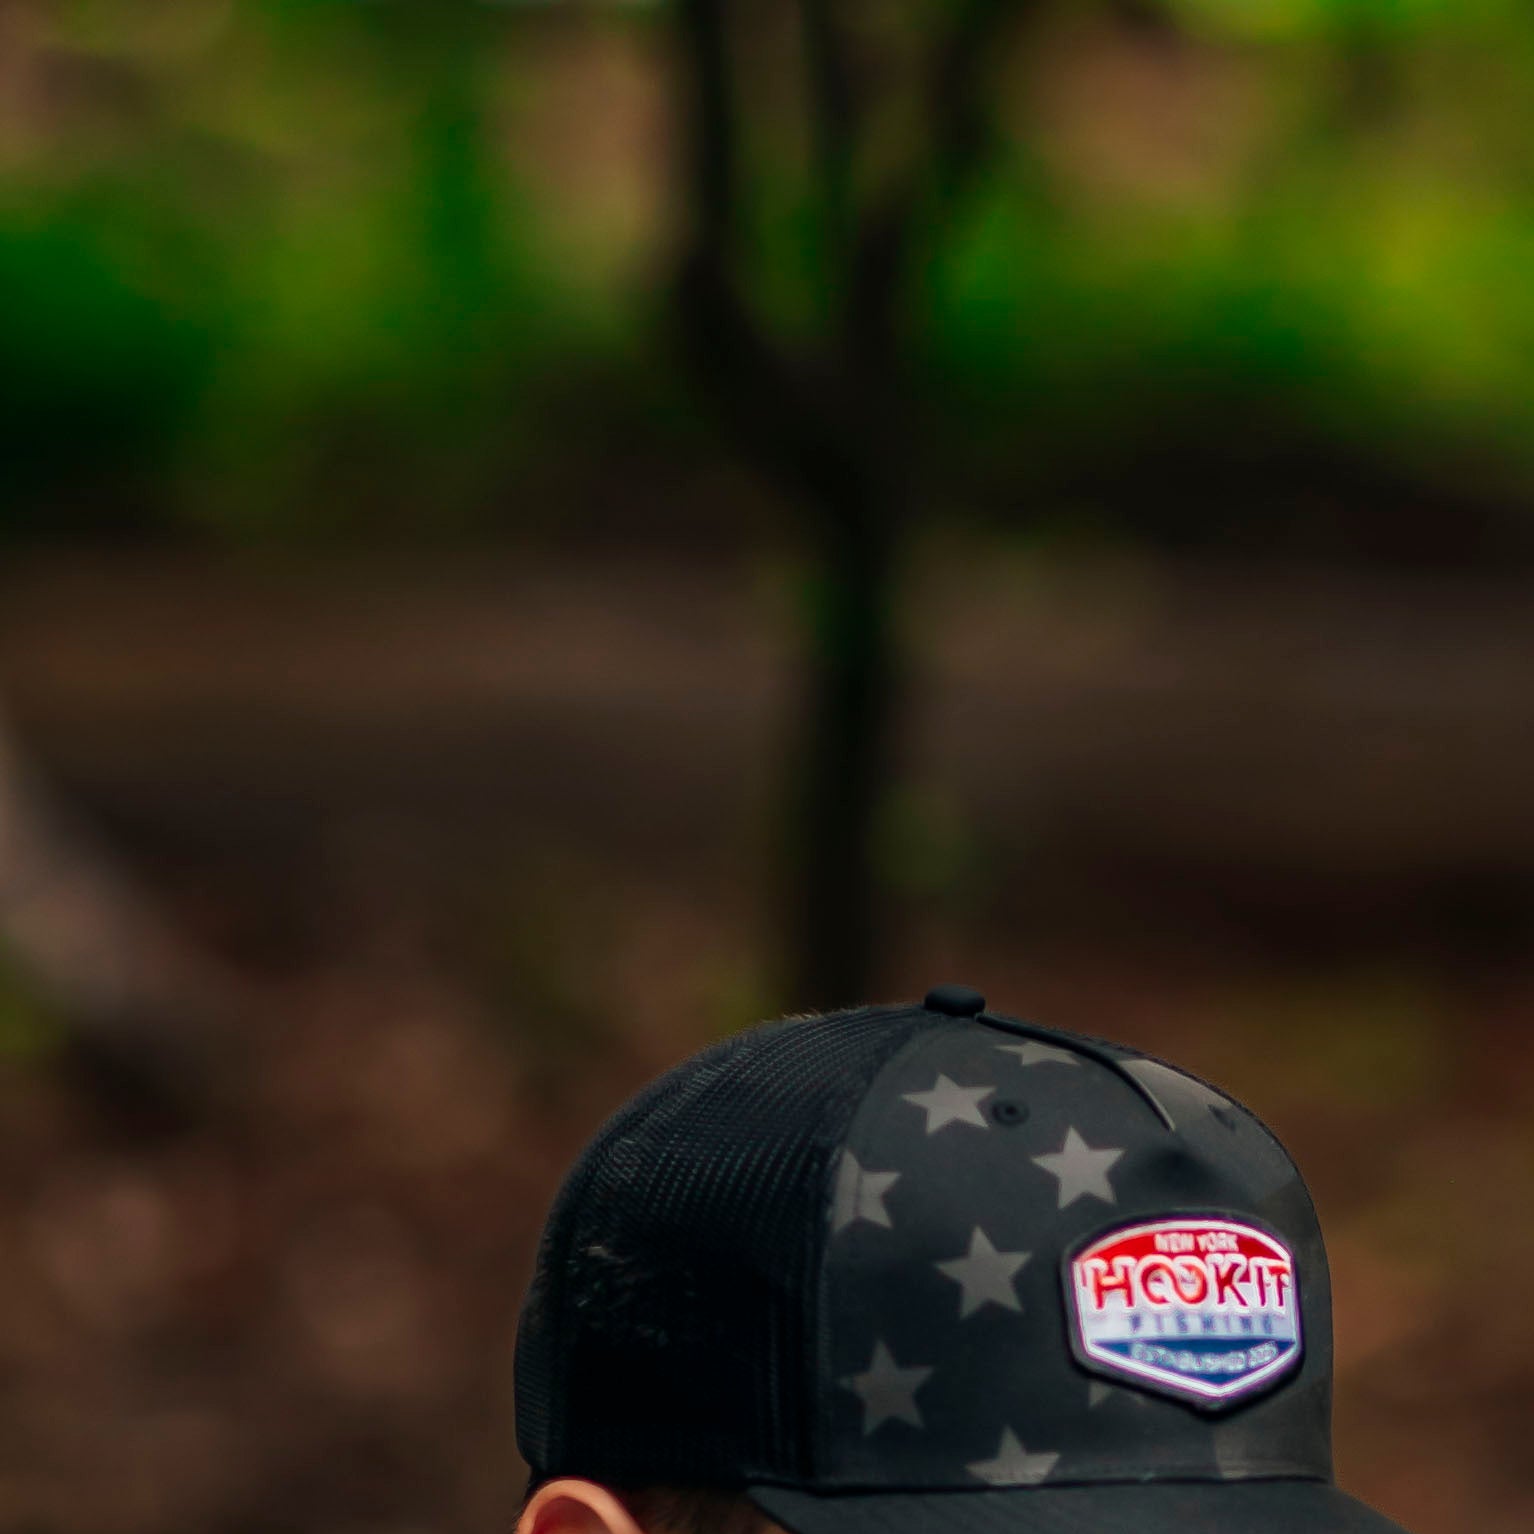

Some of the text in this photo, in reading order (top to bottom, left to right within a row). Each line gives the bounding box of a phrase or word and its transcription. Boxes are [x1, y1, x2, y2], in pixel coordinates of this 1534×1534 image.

[1154, 1233, 1240, 1252] NEW YORK
[1130, 1313, 1274, 1335] FISHING
